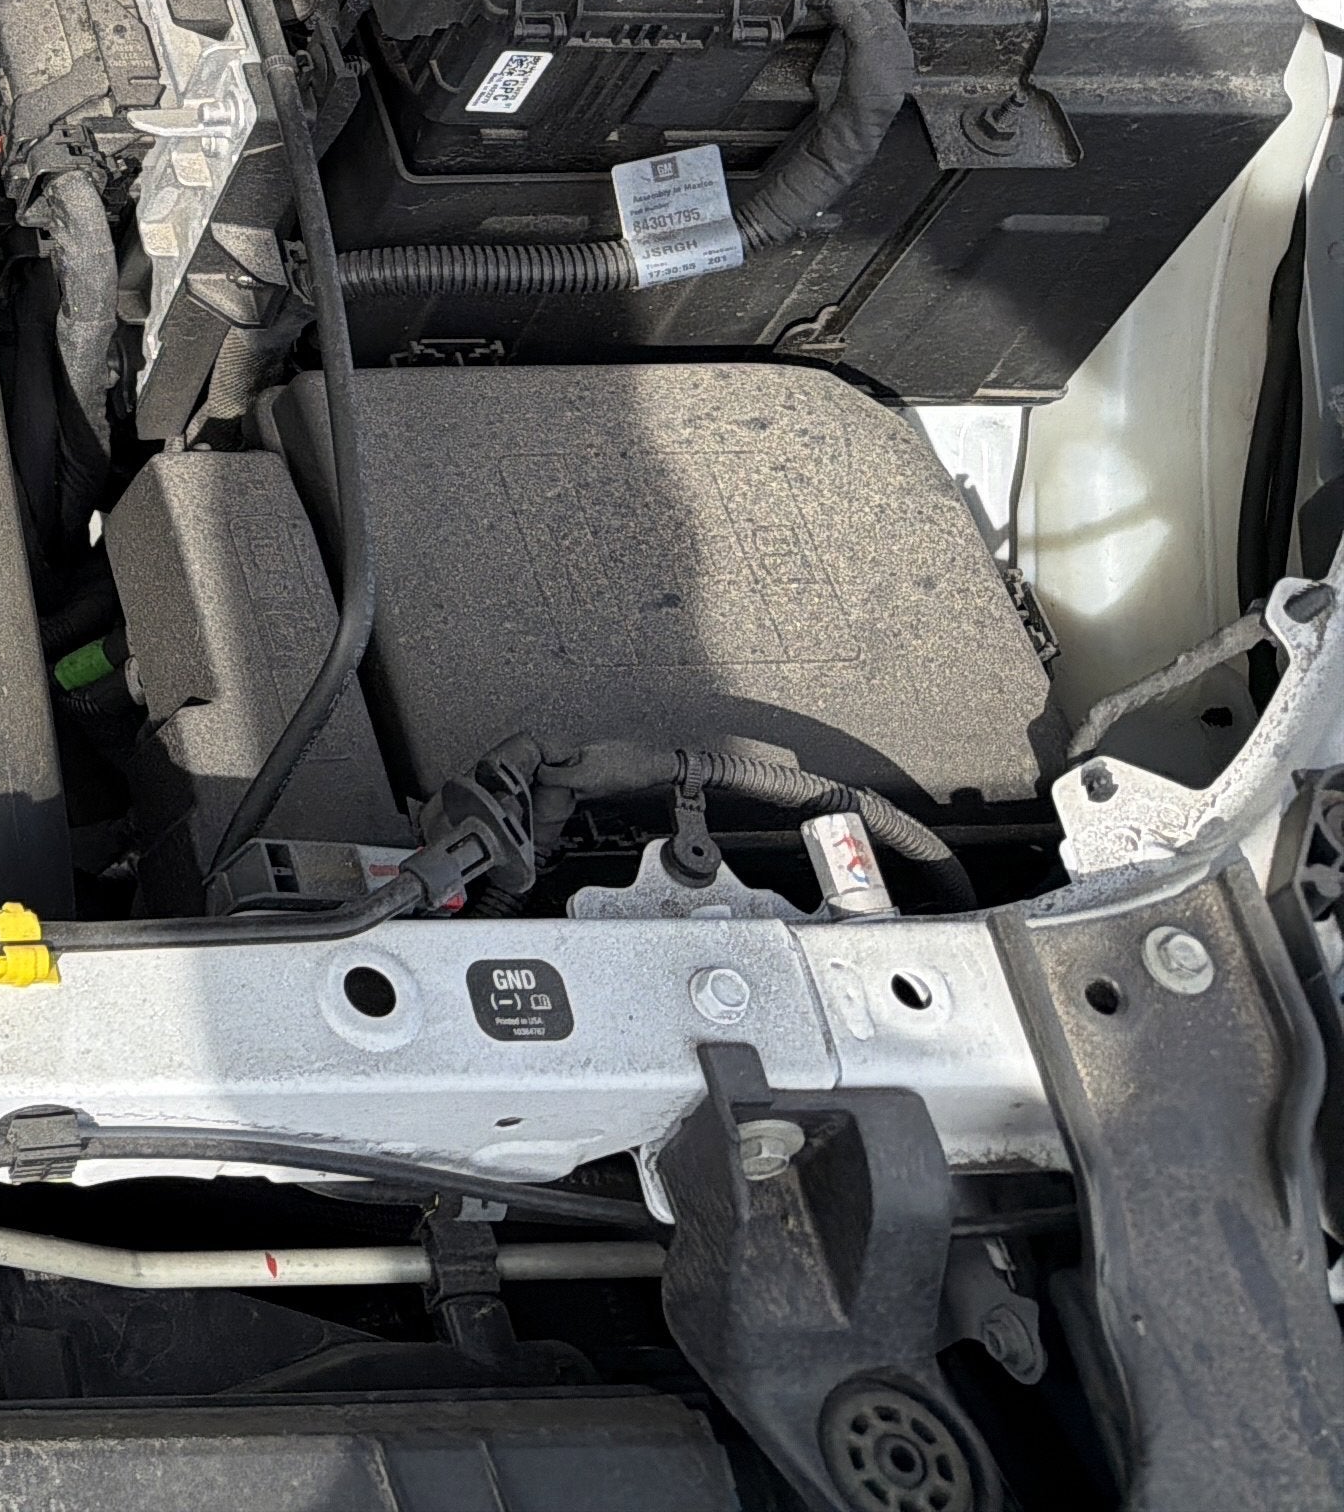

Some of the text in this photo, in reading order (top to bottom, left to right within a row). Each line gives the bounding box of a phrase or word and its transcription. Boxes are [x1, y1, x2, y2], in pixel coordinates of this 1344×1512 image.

[493, 79, 520, 101] GPC
[632, 189, 671, 203] Assembly
[684, 180, 714, 191] Mexico
[632, 207, 701, 234] 84301795
[642, 239, 698, 260] JSRGH
[492, 969, 537, 990] GND
[494, 1017, 520, 1026] Printed
[528, 1016, 544, 1025] USA
